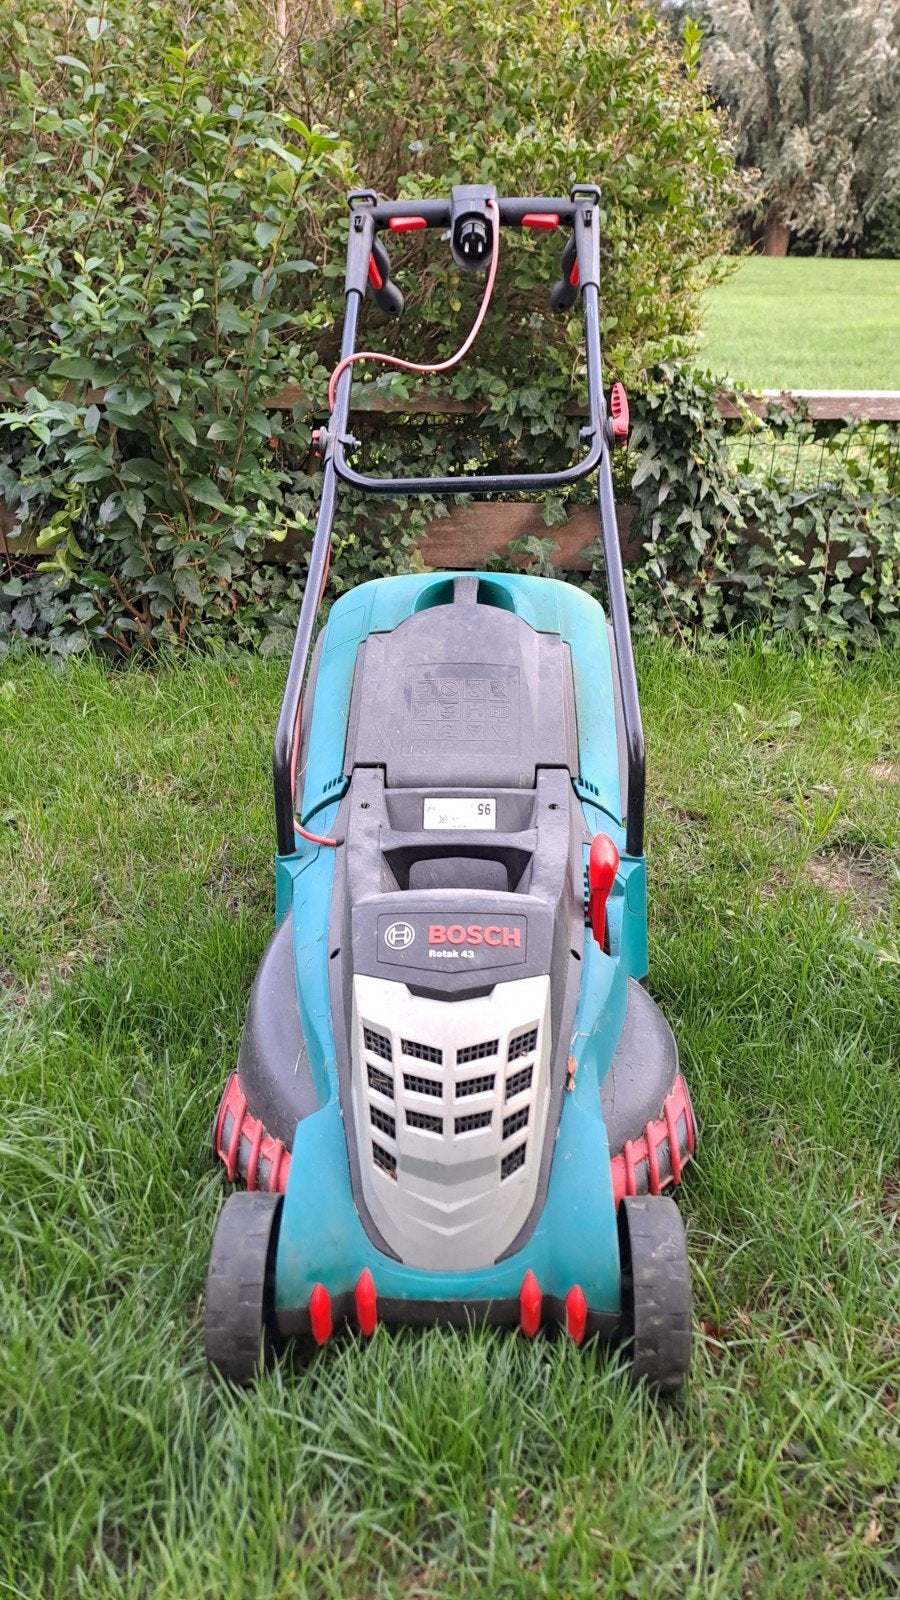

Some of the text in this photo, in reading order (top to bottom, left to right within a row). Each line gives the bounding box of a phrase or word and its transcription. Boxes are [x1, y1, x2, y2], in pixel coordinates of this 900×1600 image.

[477, 803, 491, 816] 95
[428, 925, 521, 948] BOSCH
[428, 949, 475, 958] Rotak 43
